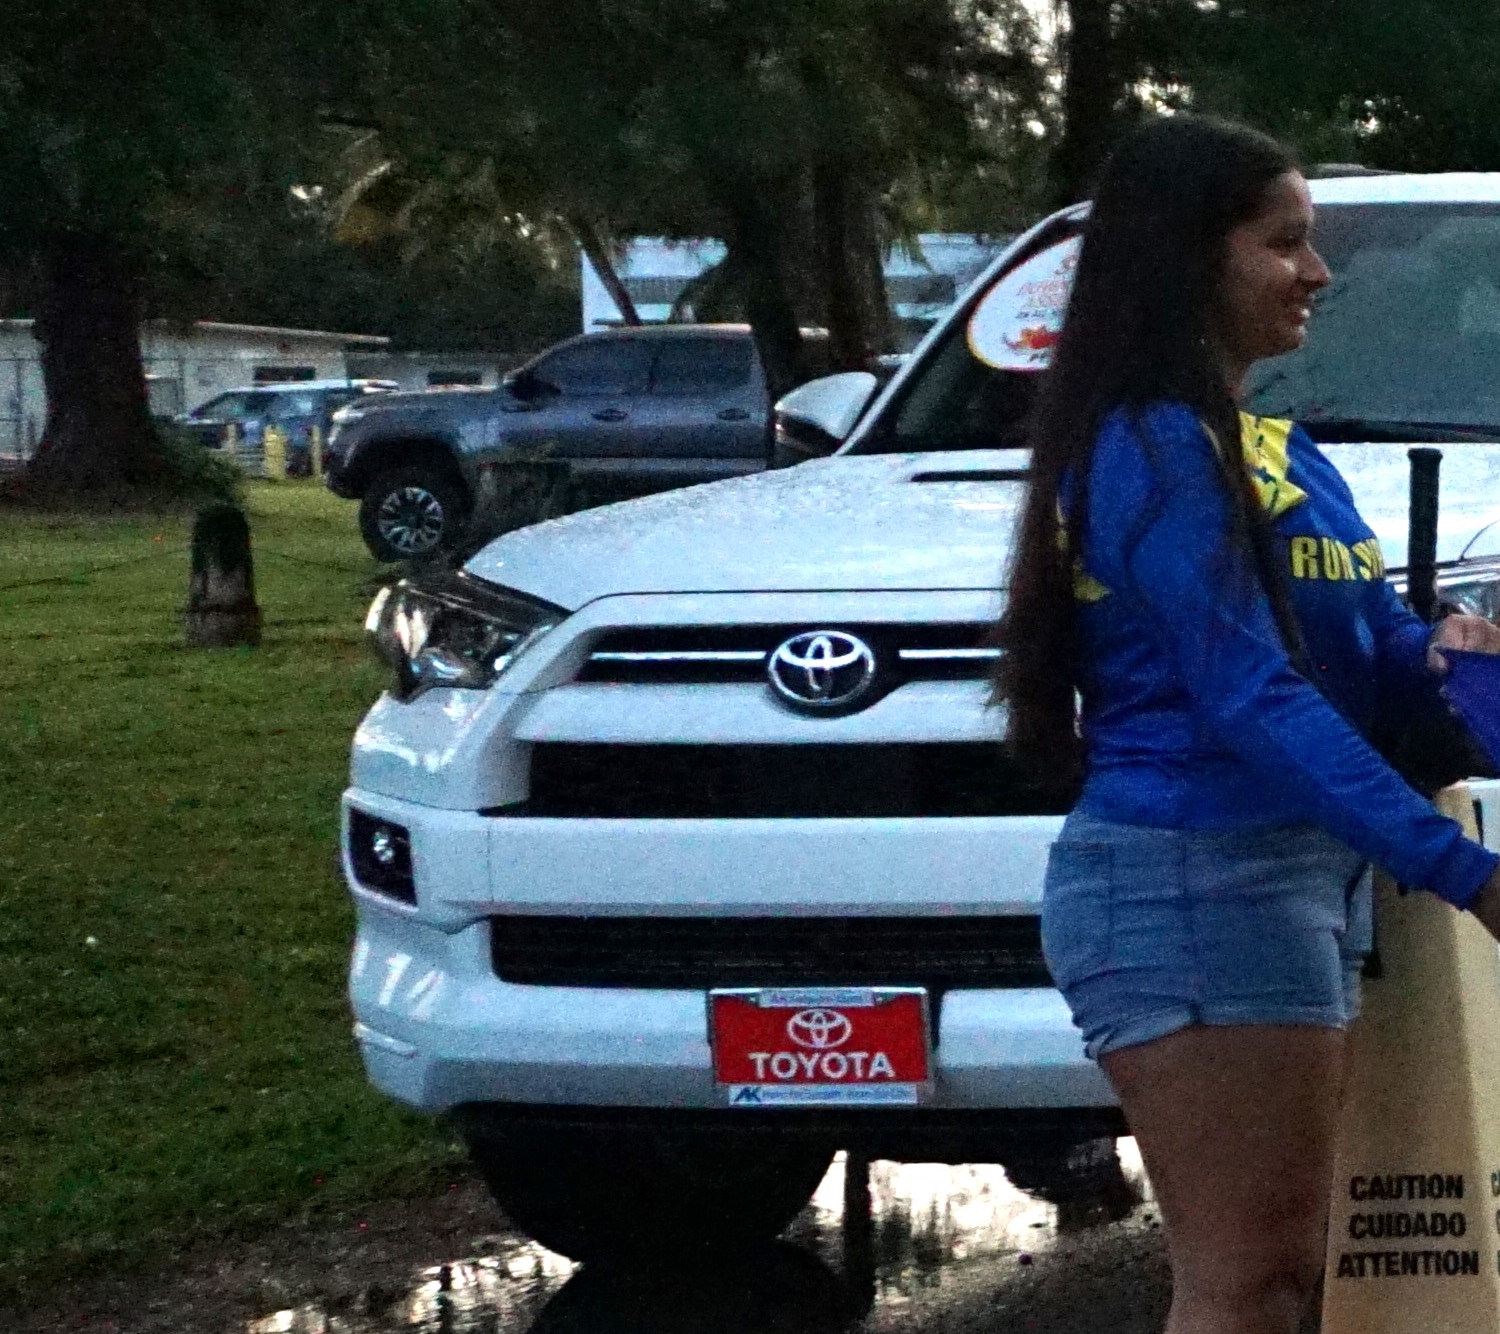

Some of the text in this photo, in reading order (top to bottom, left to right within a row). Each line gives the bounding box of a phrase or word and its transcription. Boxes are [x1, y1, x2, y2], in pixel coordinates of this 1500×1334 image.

[749, 1052, 896, 1079] TOYOTA
[1350, 1174, 1464, 1201] CAUTION
[1350, 1212, 1467, 1239] CUIDADO
[1337, 1249, 1480, 1277] ATTENTION
